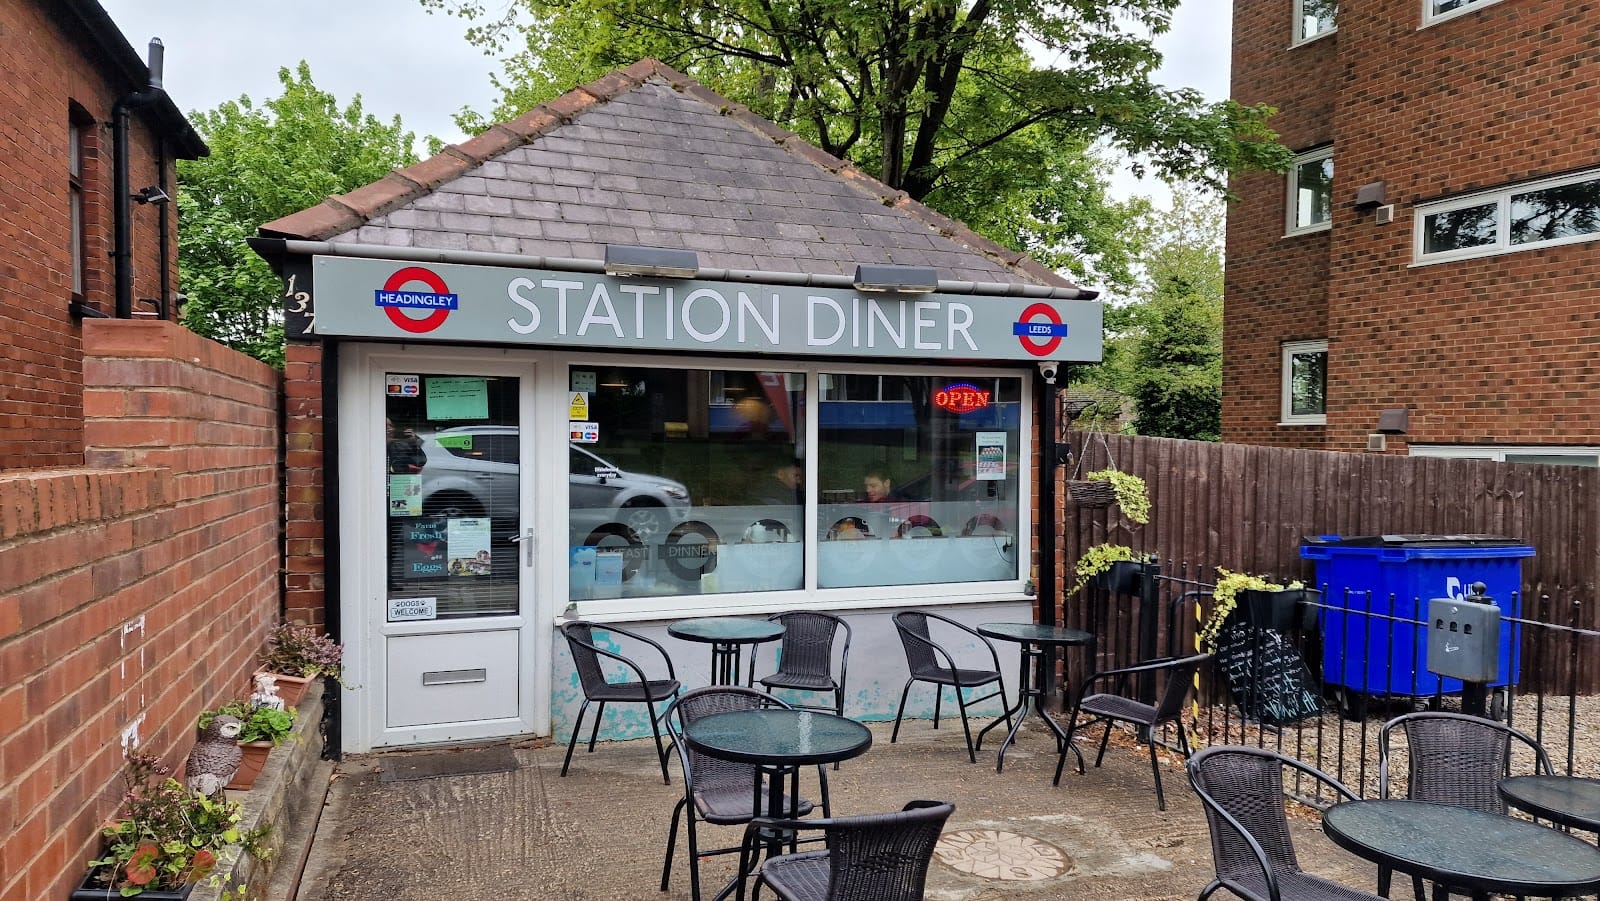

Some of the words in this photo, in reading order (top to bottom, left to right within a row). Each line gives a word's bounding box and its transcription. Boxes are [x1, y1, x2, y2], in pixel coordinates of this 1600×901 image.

[379, 292, 453, 307] HEADINGLEY
[506, 276, 781, 346] STATION
[806, 295, 980, 352] DINER
[1028, 324, 1052, 335] LEEDS
[935, 391, 990, 407] OPEN
[410, 531, 443, 540] Fresh
[412, 562, 442, 573] Eggs
[394, 607, 429, 616] WELCOME
